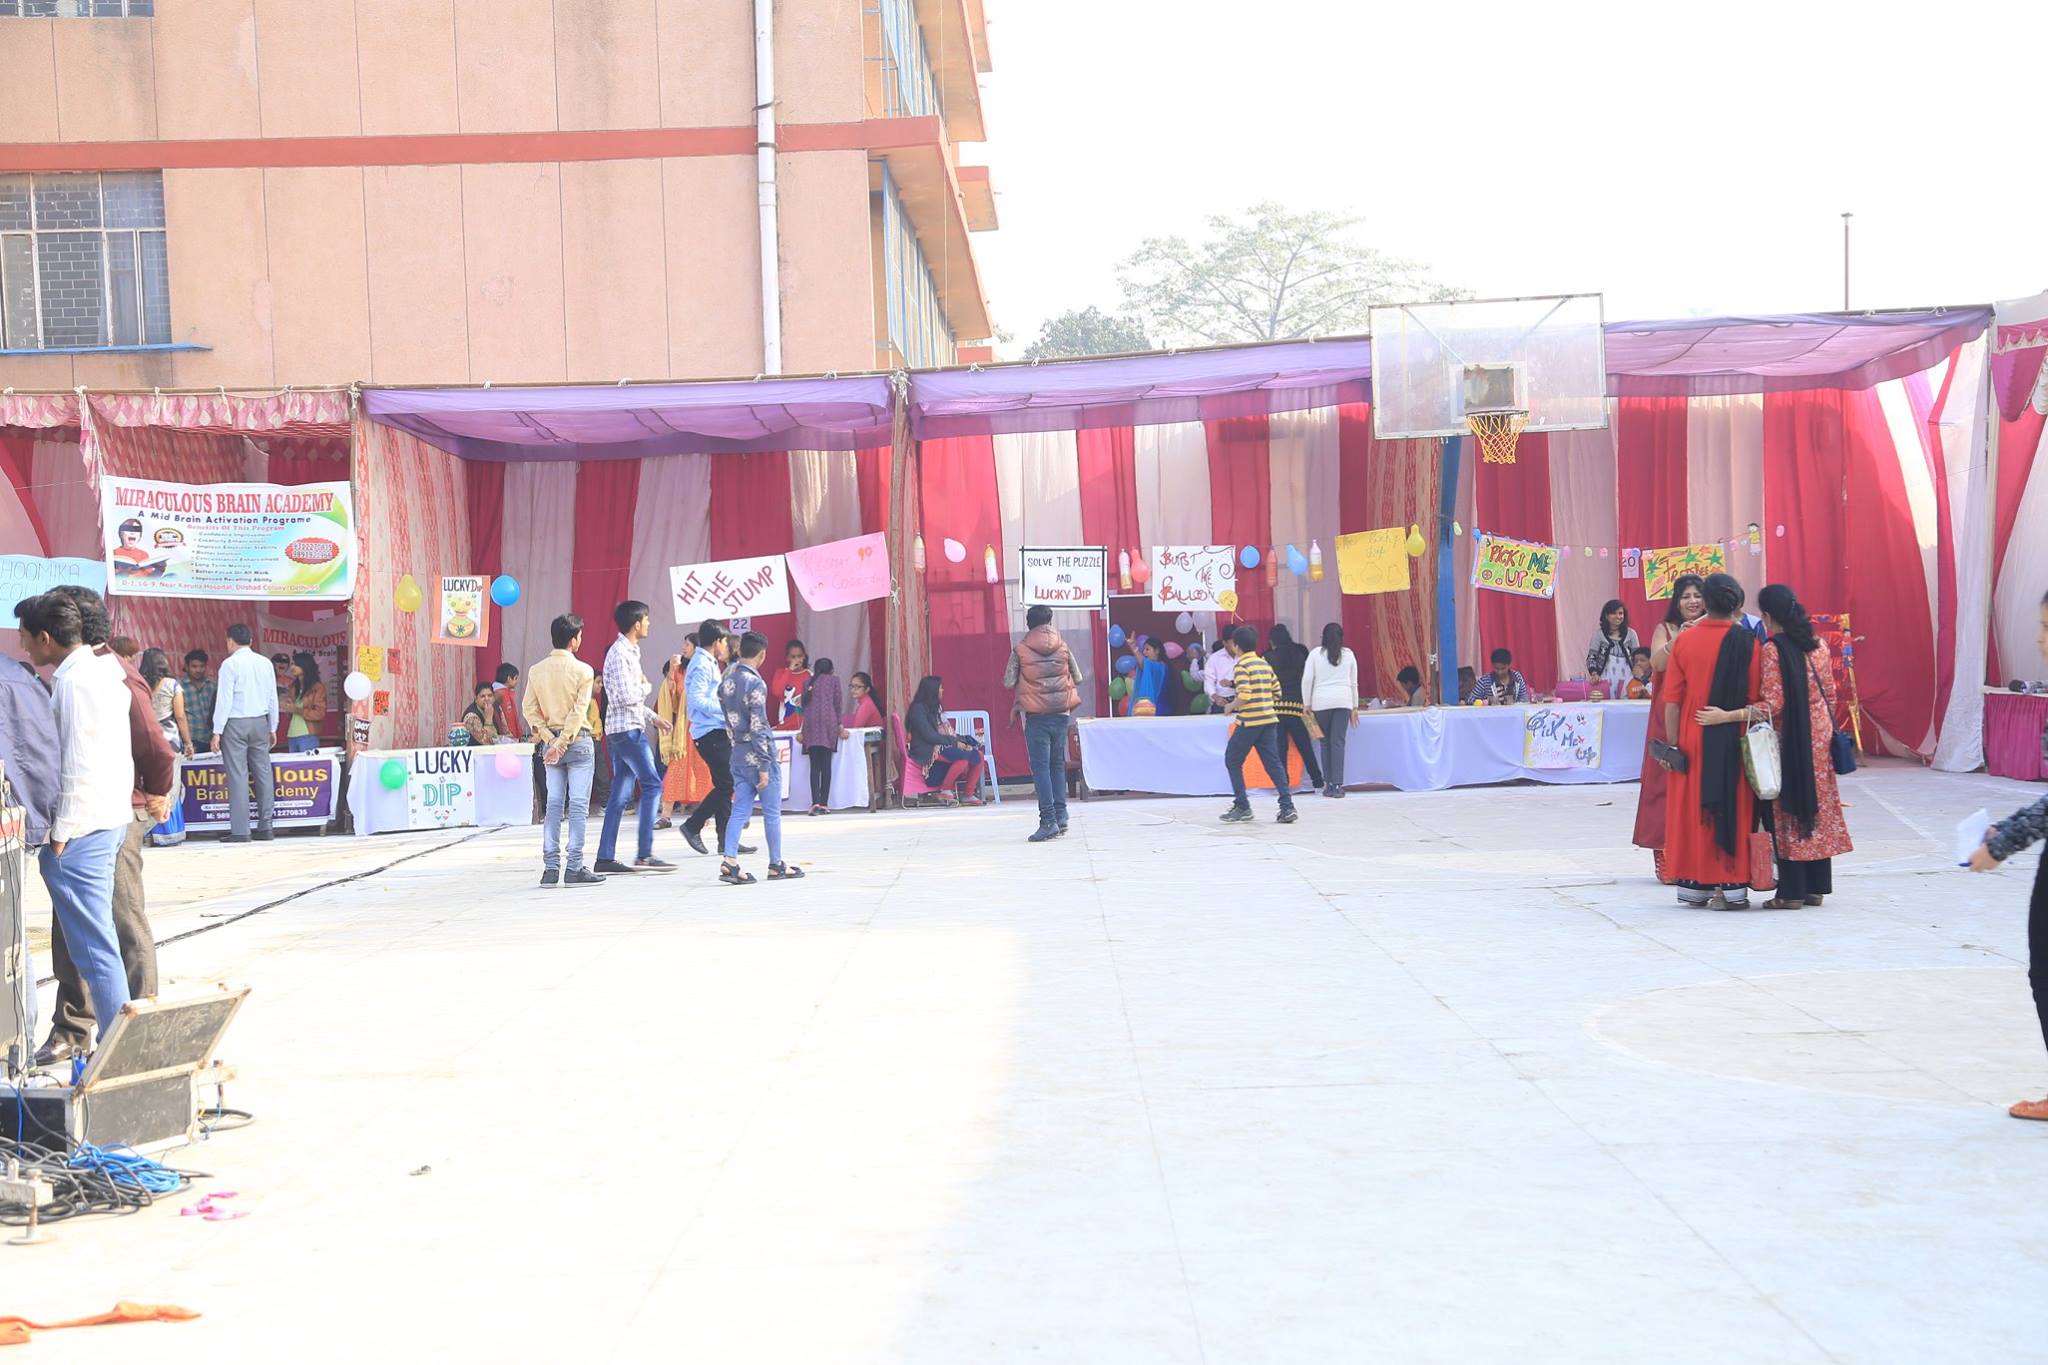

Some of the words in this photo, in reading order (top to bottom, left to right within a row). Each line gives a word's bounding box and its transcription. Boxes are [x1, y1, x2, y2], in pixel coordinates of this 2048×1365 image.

[115, 487, 212, 513] MIRACULOUS
[216, 493, 261, 513] BRAIN
[265, 492, 334, 513] ACADEMY
[138, 510, 145, 518] A
[150, 512, 170, 521] Mid
[174, 514, 201, 523] Brain
[206, 515, 258, 524] Activation
[262, 516, 311, 526] Programe
[1027, 557, 1053, 568] SOLVE
[1056, 556, 1071, 567] THE
[1073, 556, 1102, 568] PUZZLE
[1159, 546, 1203, 572] BURST
[1527, 552, 1552, 575] ME
[443, 579, 471, 592] LUCKY
[1056, 574, 1072, 583] AND
[1195, 559, 1214, 590] THE
[676, 570, 702, 606] HIT
[699, 570, 733, 606] THE
[722, 565, 775, 615] STUMP
[1034, 585, 1071, 601] LUCKY
[1072, 586, 1092, 601] DIP
[1158, 576, 1219, 605] BALLOON
[732, 618, 748, 629] 22
[263, 628, 347, 649] MIRACULOUS
[415, 749, 472, 774] LUCKY
[187, 766, 329, 786] Mirlous
[196, 788, 229, 801] Brai
[422, 782, 462, 807] DIP
